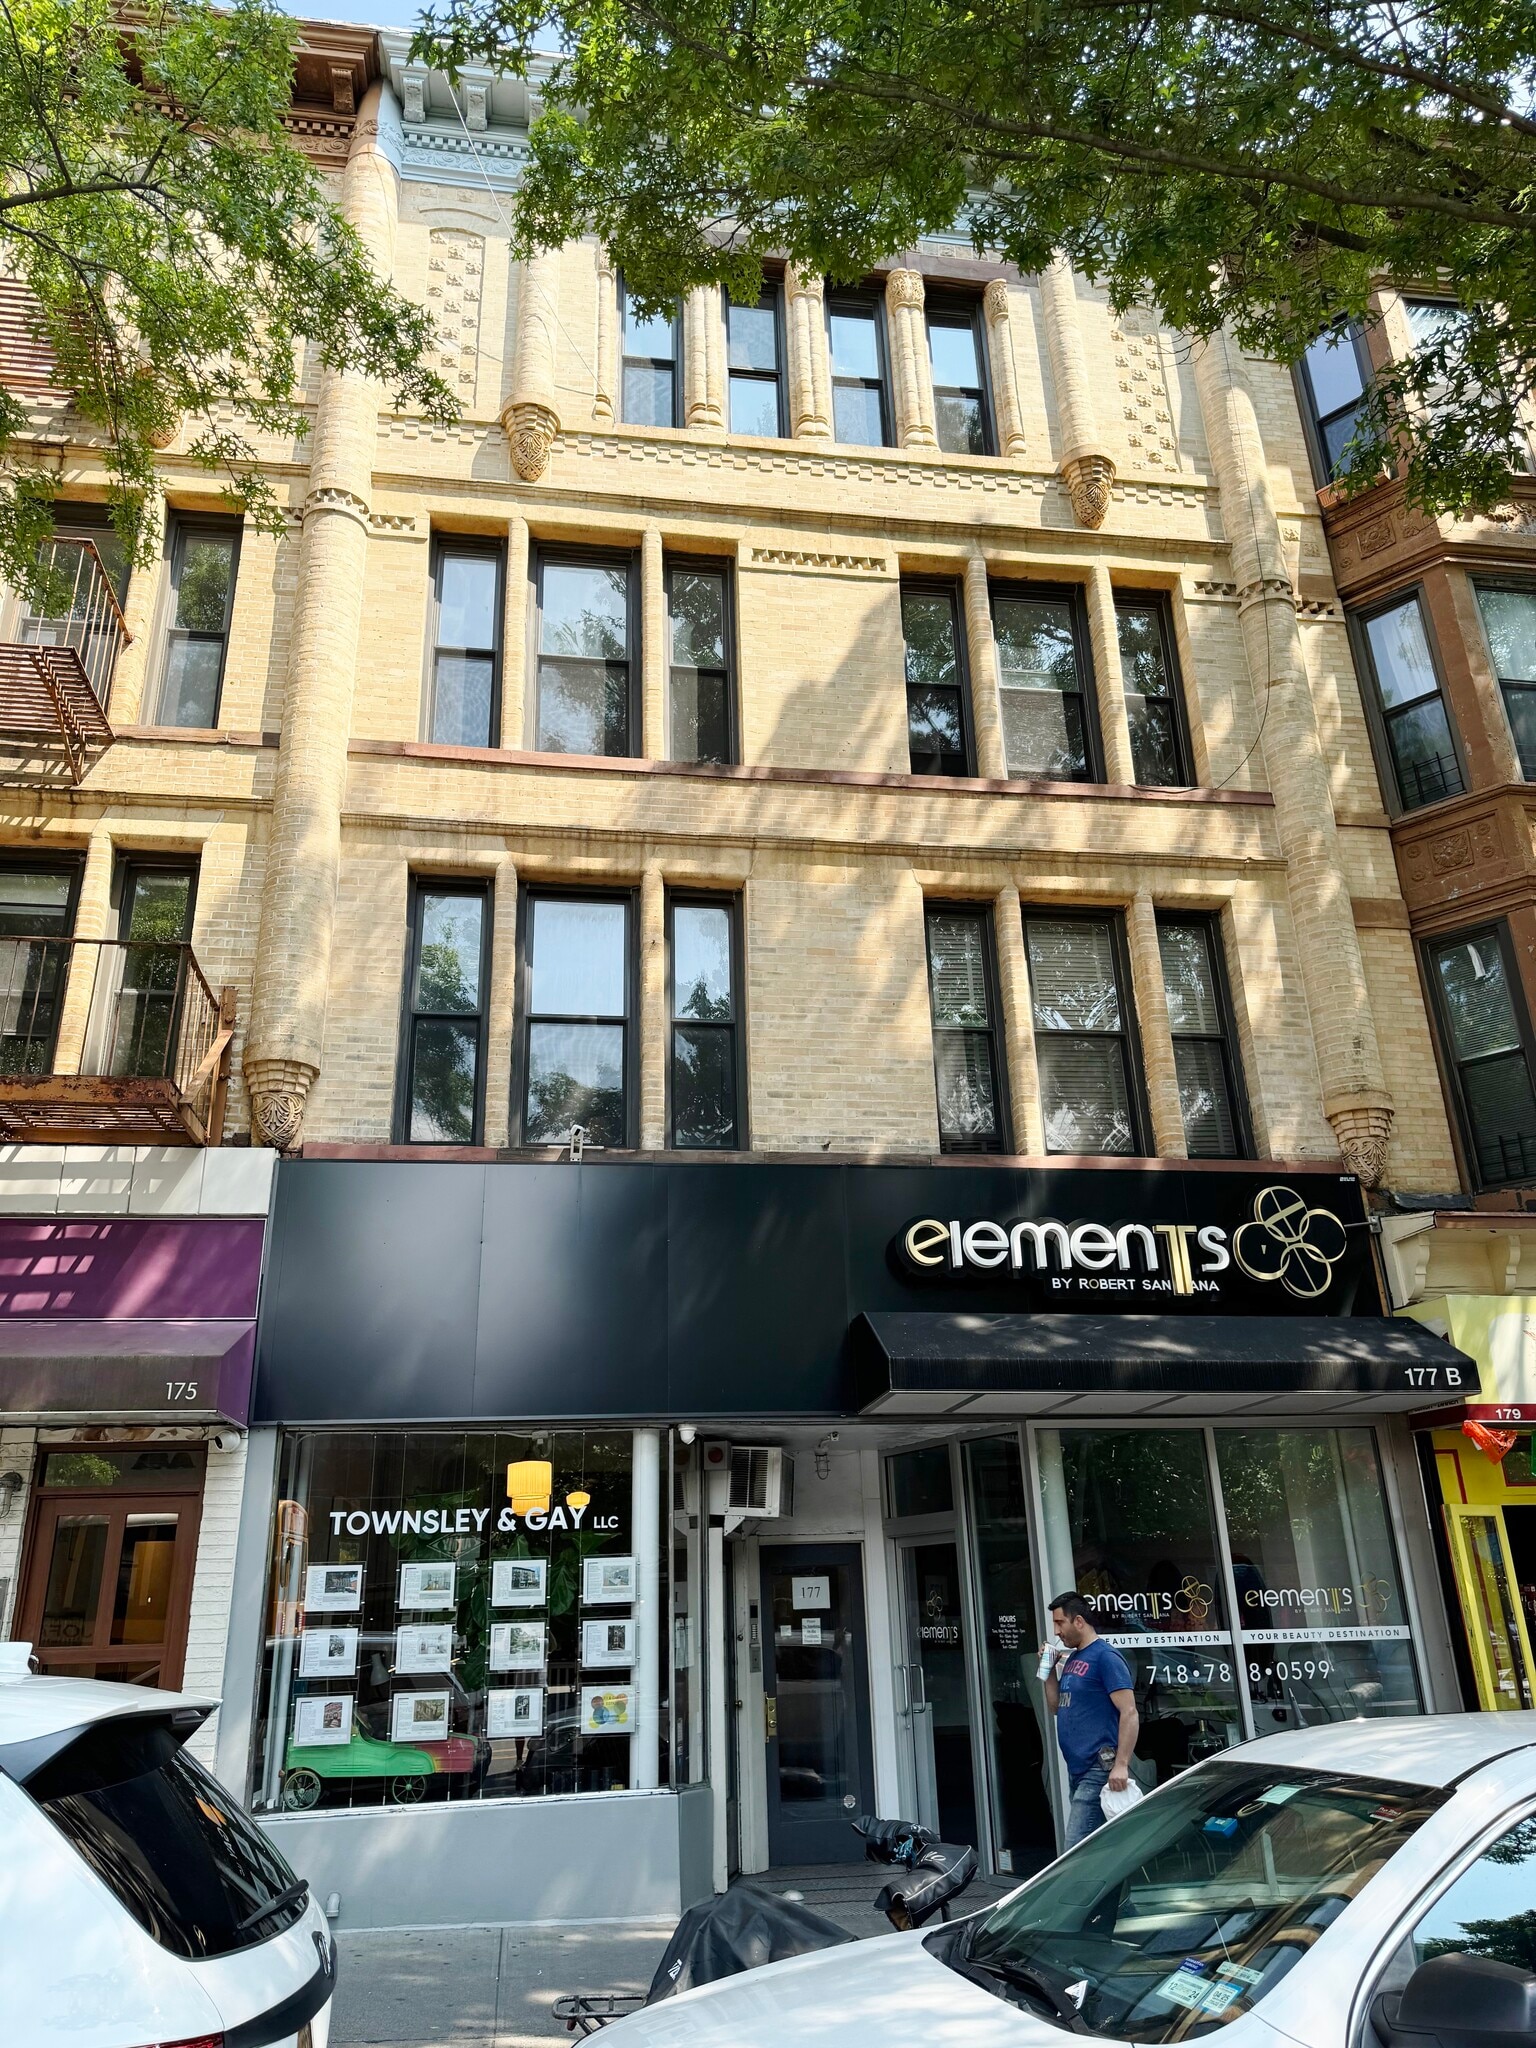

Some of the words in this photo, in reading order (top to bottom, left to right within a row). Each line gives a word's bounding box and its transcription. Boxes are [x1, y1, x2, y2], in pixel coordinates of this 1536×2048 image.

[1052, 1277, 1072, 1289] BY
[1079, 1278, 1135, 1290] ROBERT
[1404, 1367, 1438, 1386] 177
[1445, 1367, 1462, 1385] B
[166, 1382, 198, 1400] 175
[1495, 1408, 1521, 1420] 179
[329, 1507, 490, 1535] TOWNSLEY
[497, 1510, 516, 1532] &
[525, 1505, 588, 1531] GAY
[593, 1516, 619, 1529] LLC
[801, 1586, 821, 1598] 177
[1105, 1637, 1140, 1645] EAUTY
[1146, 1634, 1221, 1644] DESTINATION
[1250, 1632, 1280, 1641] YOUR
[1282, 1630, 1323, 1640] BEAUTY
[1328, 1628, 1401, 1639] DESTINATION
